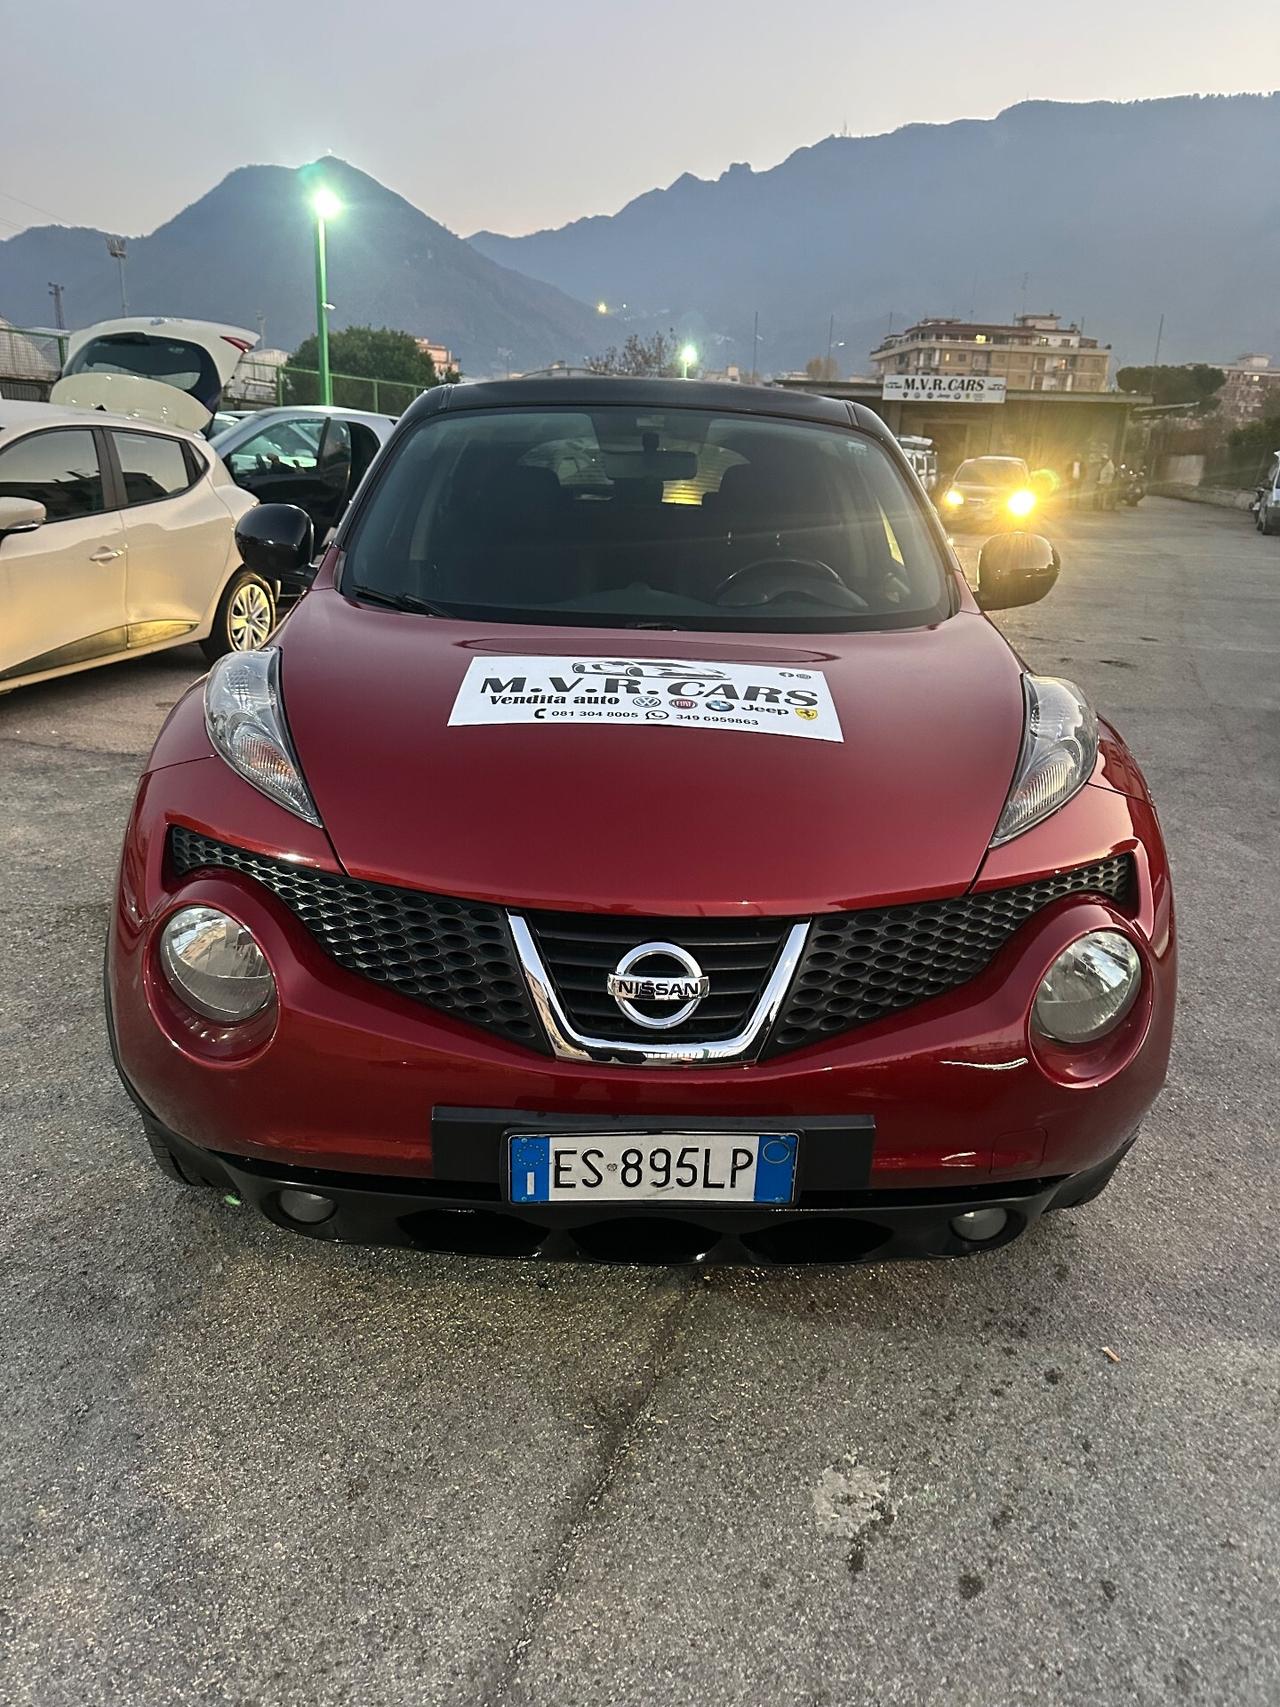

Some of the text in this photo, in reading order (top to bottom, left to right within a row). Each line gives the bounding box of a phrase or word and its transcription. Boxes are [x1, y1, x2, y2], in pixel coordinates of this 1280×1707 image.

[490, 694, 620, 705] Vendita auto
[741, 704, 789, 716] Jeep
[618, 979, 699, 996] NISSAN
[553, 1147, 754, 1189] ES 895LP
